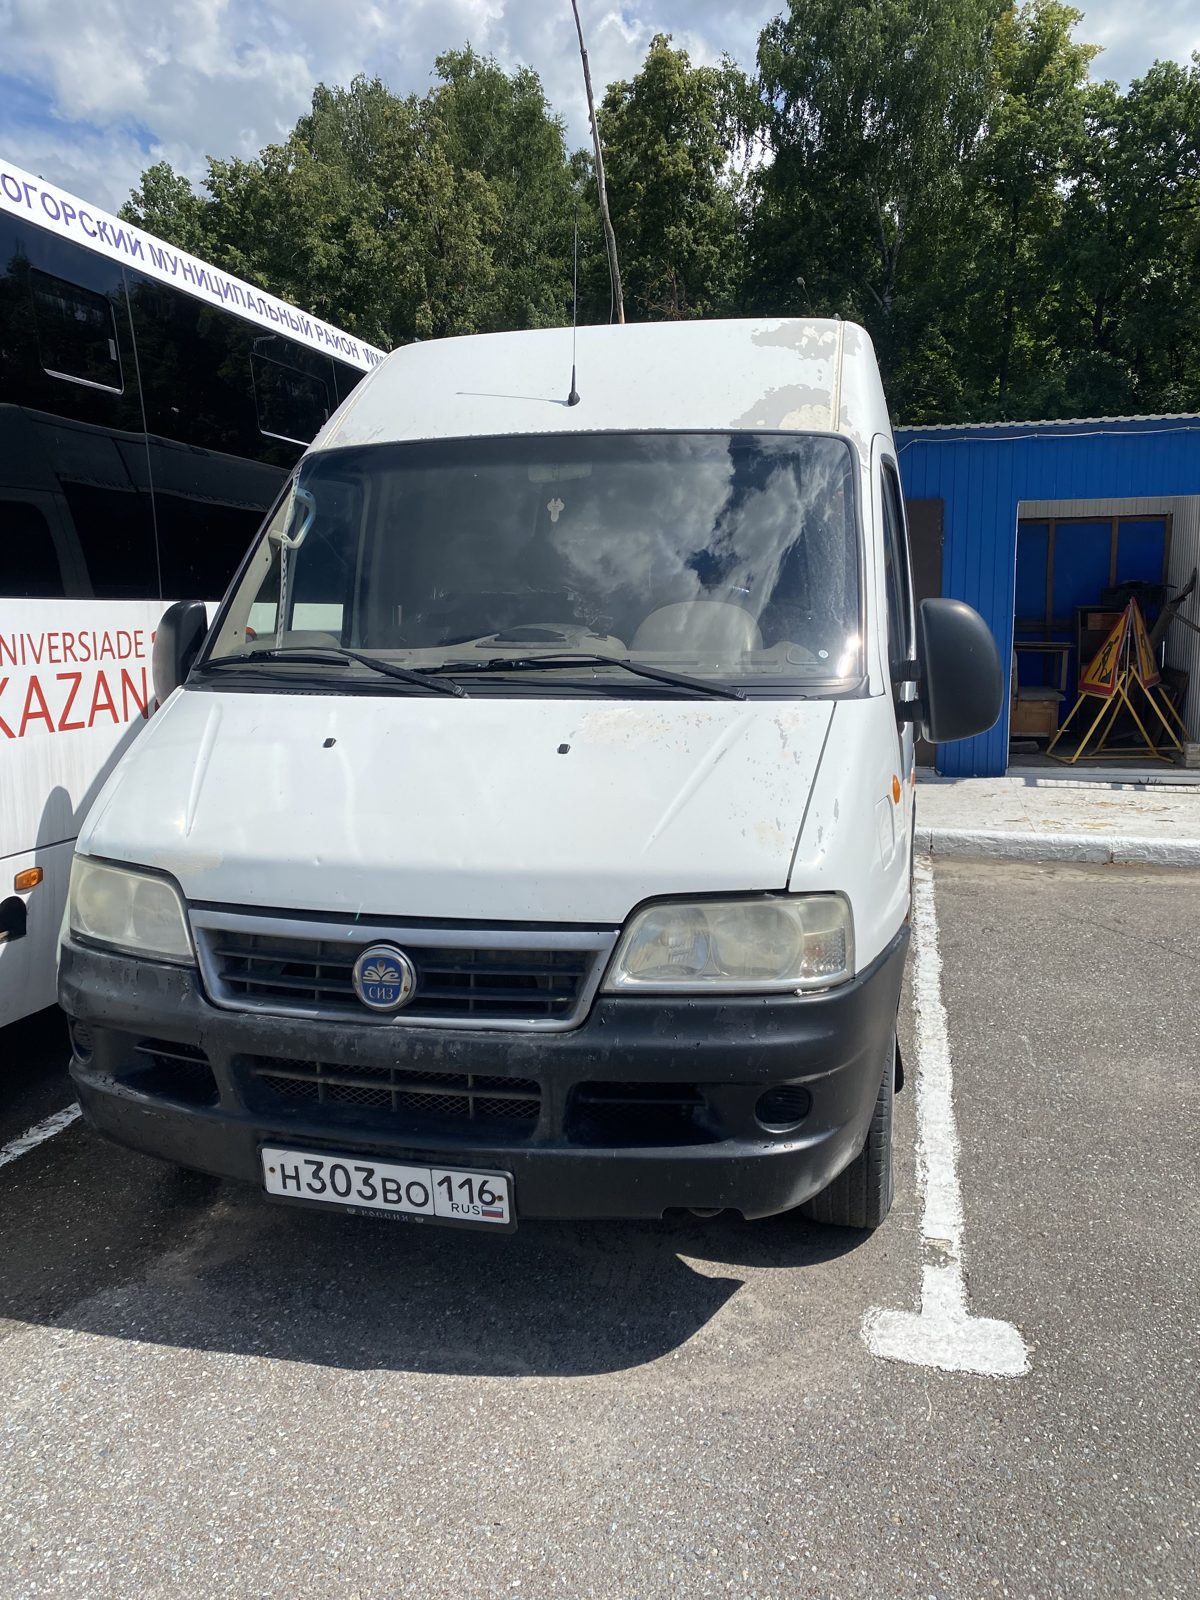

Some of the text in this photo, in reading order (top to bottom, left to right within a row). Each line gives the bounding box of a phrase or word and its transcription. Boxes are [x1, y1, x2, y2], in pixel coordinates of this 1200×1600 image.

[0, 173, 360, 360] ОГОРСКИЙ МУНИЦИПАЛЬНЫЙ РАЙОН
[368, 986, 393, 999] СИЗ
[437, 1175, 497, 1206] 116
[451, 1203, 481, 1215] RUS
